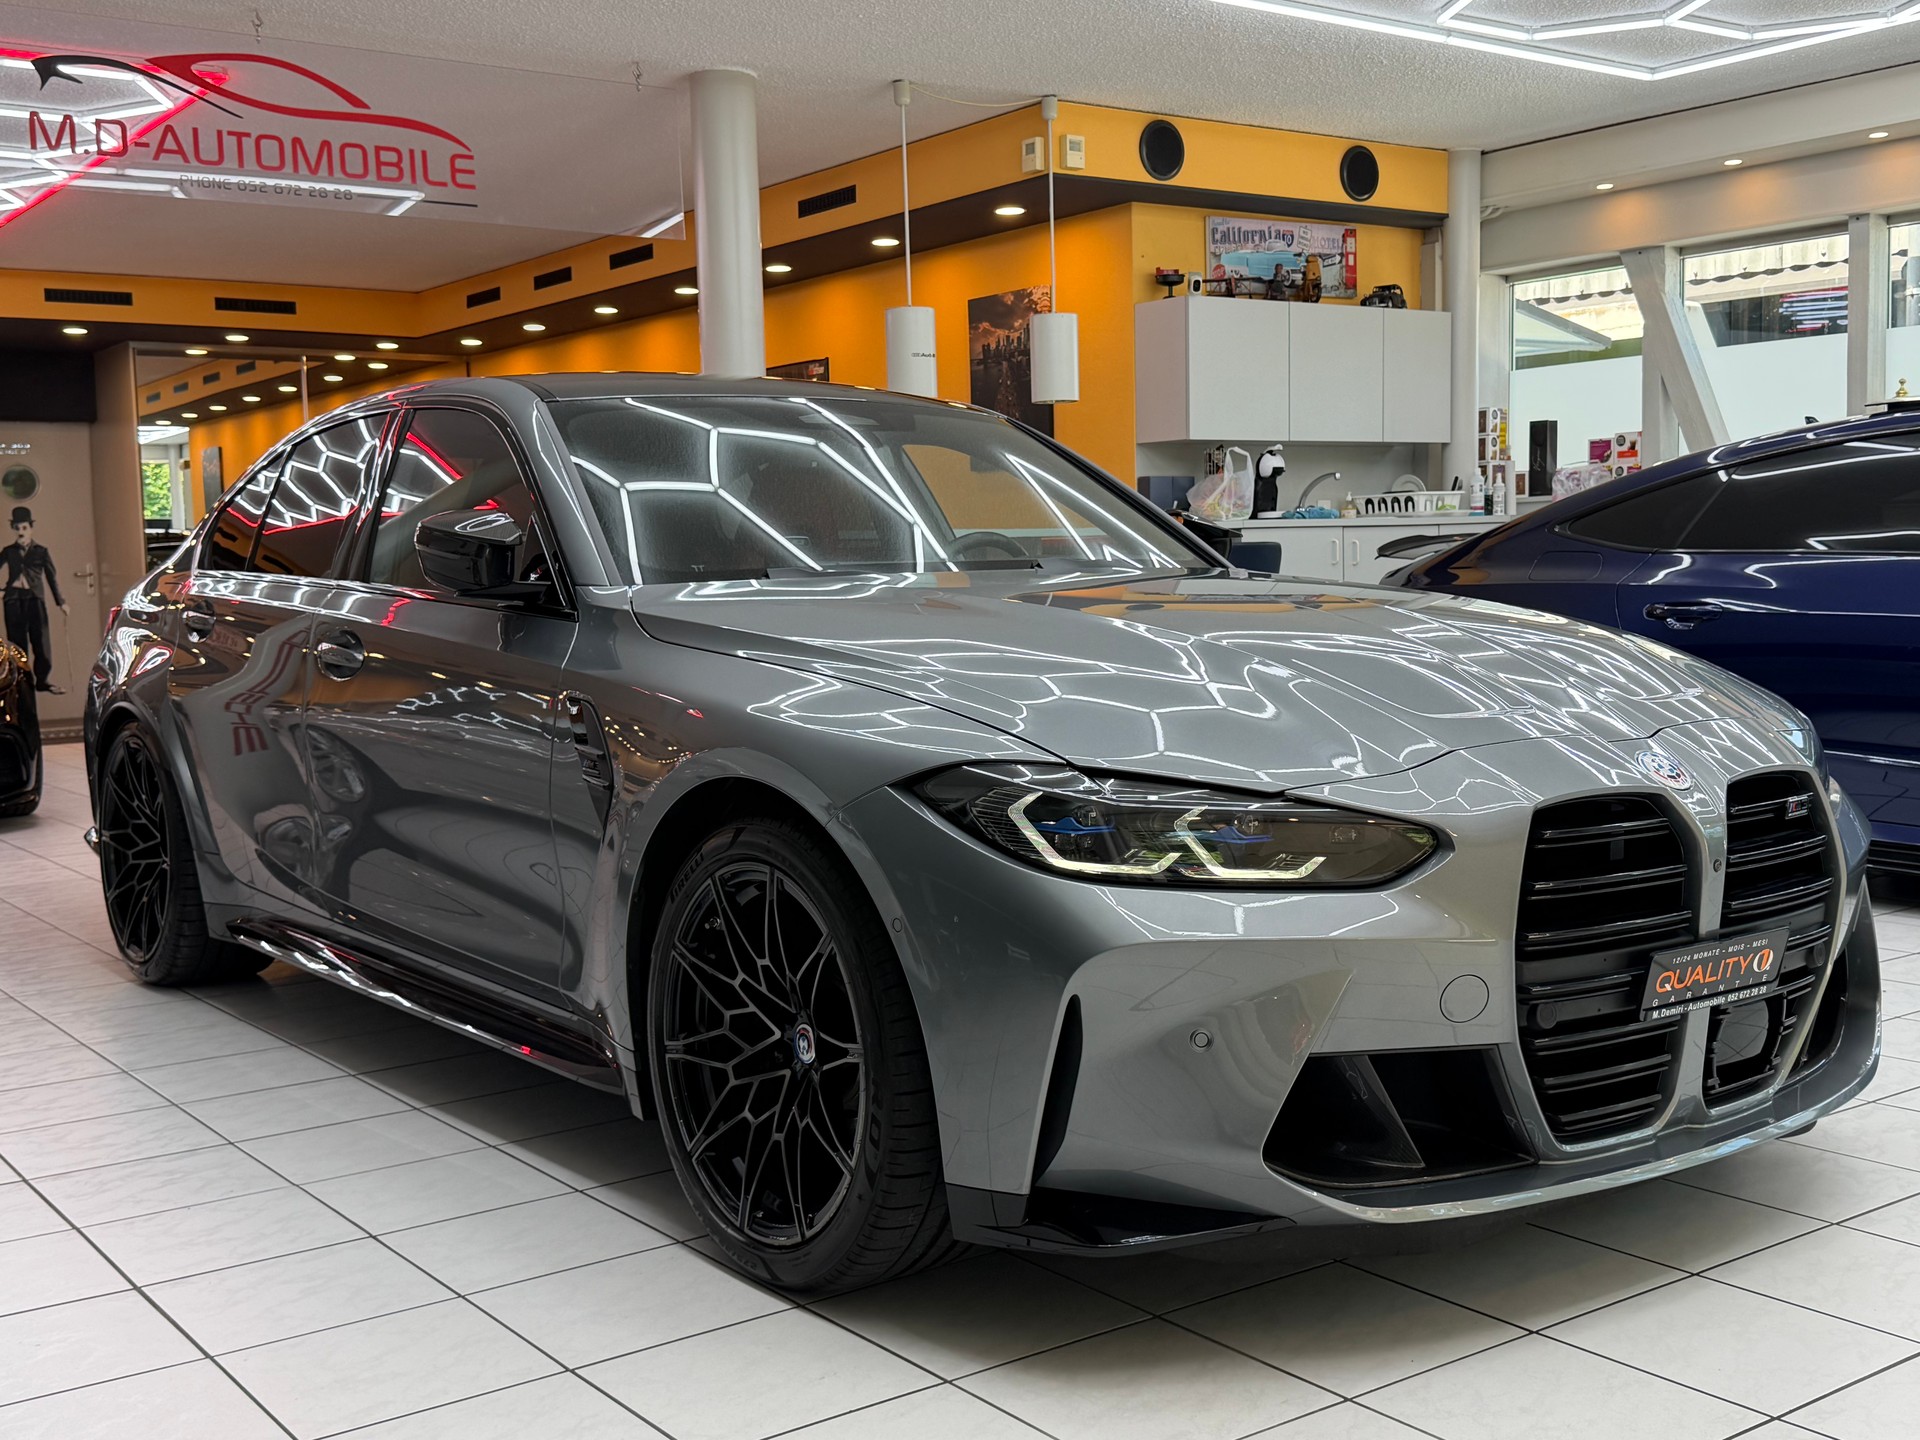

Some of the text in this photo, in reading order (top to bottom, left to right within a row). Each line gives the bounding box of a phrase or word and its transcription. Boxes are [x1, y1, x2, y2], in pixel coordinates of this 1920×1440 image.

[29, 110, 476, 190] M.D-AUTOMOBILE
[179, 174, 353, 201] PHONE 052 672 28 28
[1212, 225, 1281, 245] California
[1672, 955, 1691, 965] 12/24
[1693, 949, 1720, 960] MONATE
[1728, 943, 1745, 953] MOIS
[1752, 939, 1769, 947] MESI
[1655, 953, 1754, 993] QUALITY
[1652, 974, 1768, 1007] GARANTIE
[1727, 992, 1738, 1003] 052
[1739, 989, 1750, 999] 672
[1750, 987, 1759, 996] 28
[1759, 985, 1767, 994] 28
